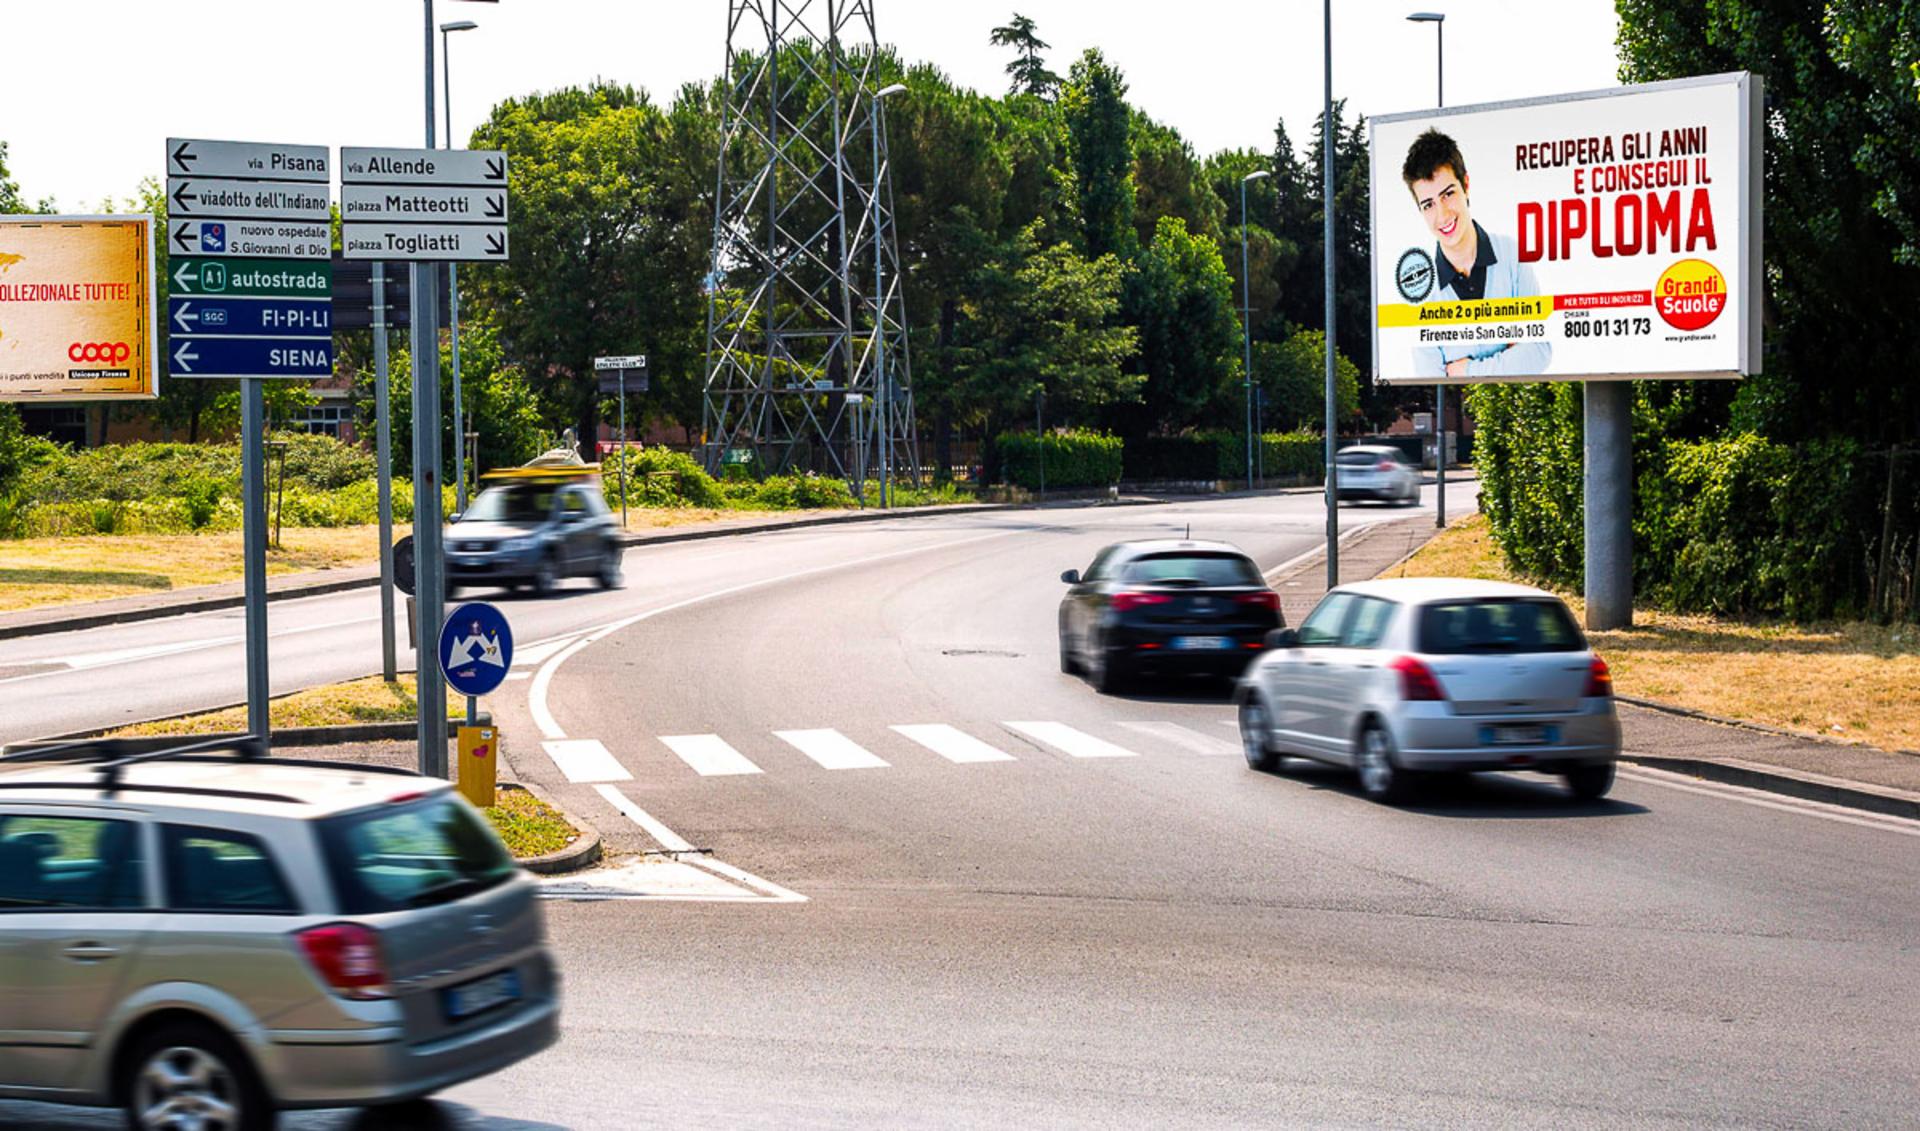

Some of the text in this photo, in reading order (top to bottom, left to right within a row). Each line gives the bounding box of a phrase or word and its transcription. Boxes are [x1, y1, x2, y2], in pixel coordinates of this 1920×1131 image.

[1516, 126, 1707, 171] RECUPERA GLI ANNI
[248, 153, 326, 172] via Pisana
[347, 156, 435, 175] via Allende
[1574, 158, 1712, 194] E CONSEGUI IL
[200, 190, 326, 210] viadotto dell'Indiano
[347, 195, 469, 214] piazza Matteotti
[240, 226, 327, 239] nuovo ospedale
[1517, 187, 1717, 263] DIPLOMA
[230, 241, 327, 256] S.Giovanni di Dio
[348, 233, 460, 253] piazza Togliatti
[231, 270, 327, 289] autostrada
[1663, 275, 1718, 295] Grandi
[84, 283, 129, 300] TUTTE!
[1419, 301, 1541, 320] Anche 2 o più anni in 1
[1663, 296, 1719, 314] Scuole
[204, 309, 328, 328] SGC FI-PI-LI
[1564, 318, 1651, 338] 800 01 31 73
[1420, 324, 1545, 341] Firenze via San Gallo 103
[68, 341, 130, 367] coop
[269, 349, 328, 367] SIENA
[33, 372, 65, 380] vendita
